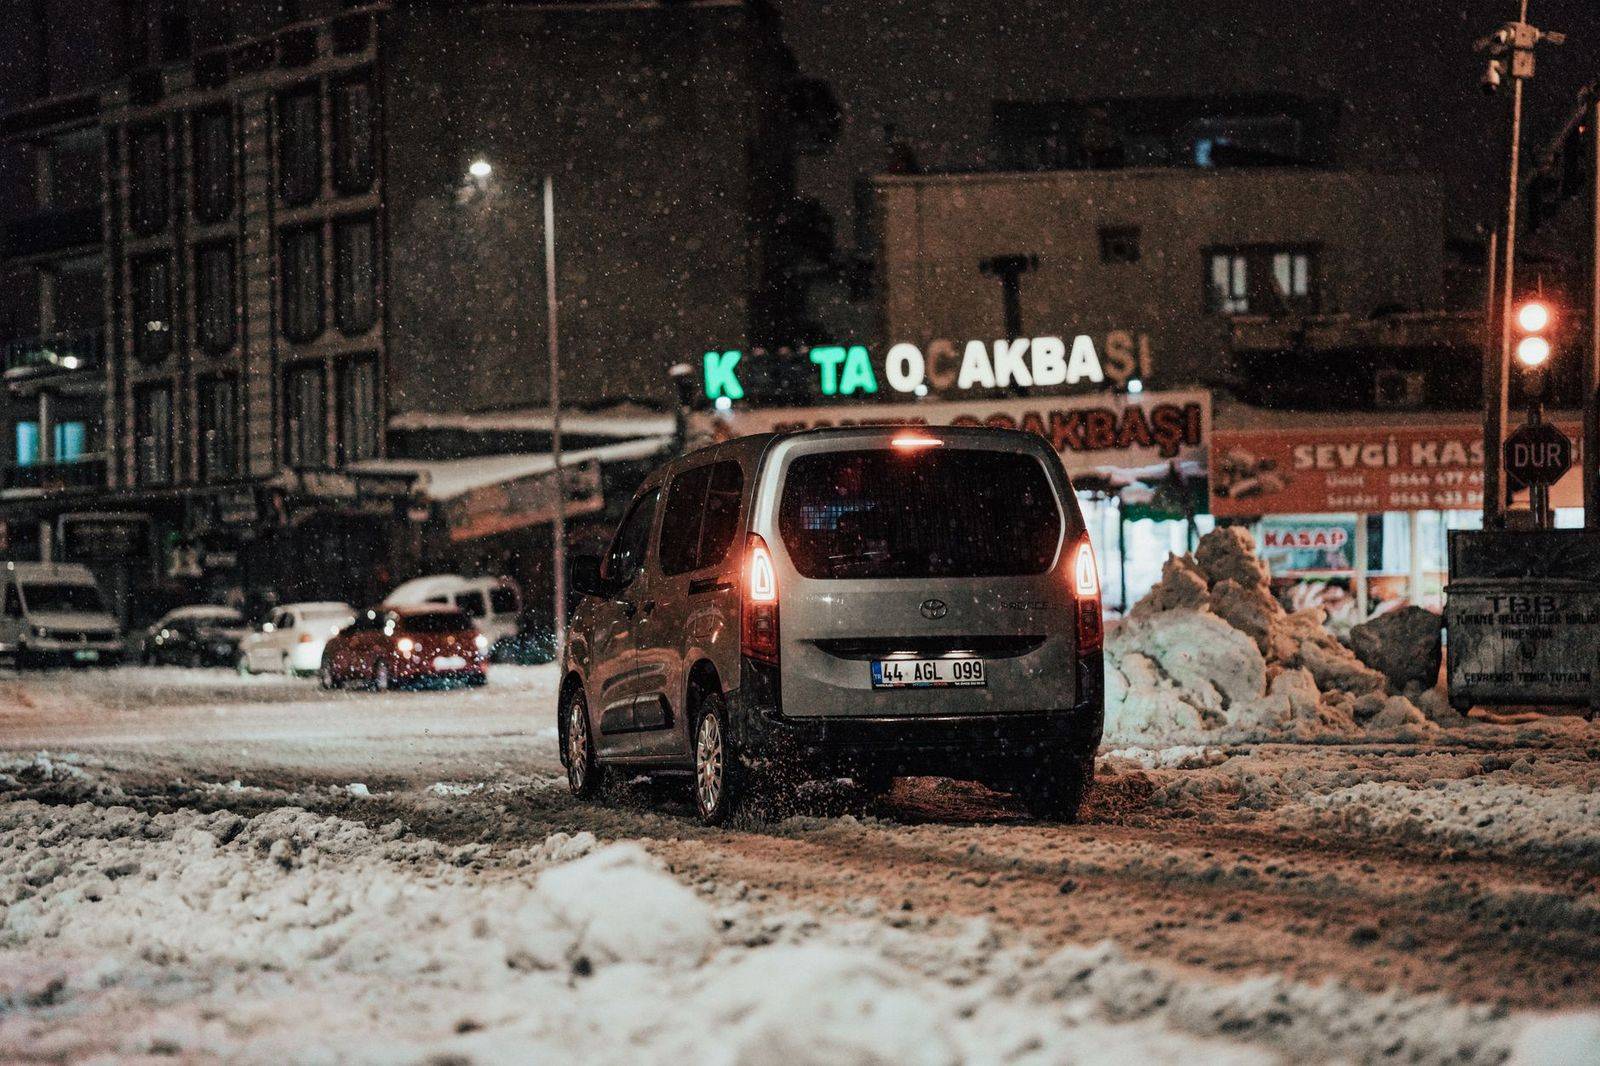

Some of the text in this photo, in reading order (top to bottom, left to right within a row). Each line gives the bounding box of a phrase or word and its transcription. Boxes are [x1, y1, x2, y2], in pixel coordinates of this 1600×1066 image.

[1293, 433, 1399, 469] SEVGİ
[1514, 442, 1563, 468] DUR
[1263, 529, 1347, 547] KASAP
[1485, 596, 1557, 613] TBB
[884, 663, 903, 681] 44
[914, 662, 942, 681] AGL
[953, 661, 983, 680] 099
